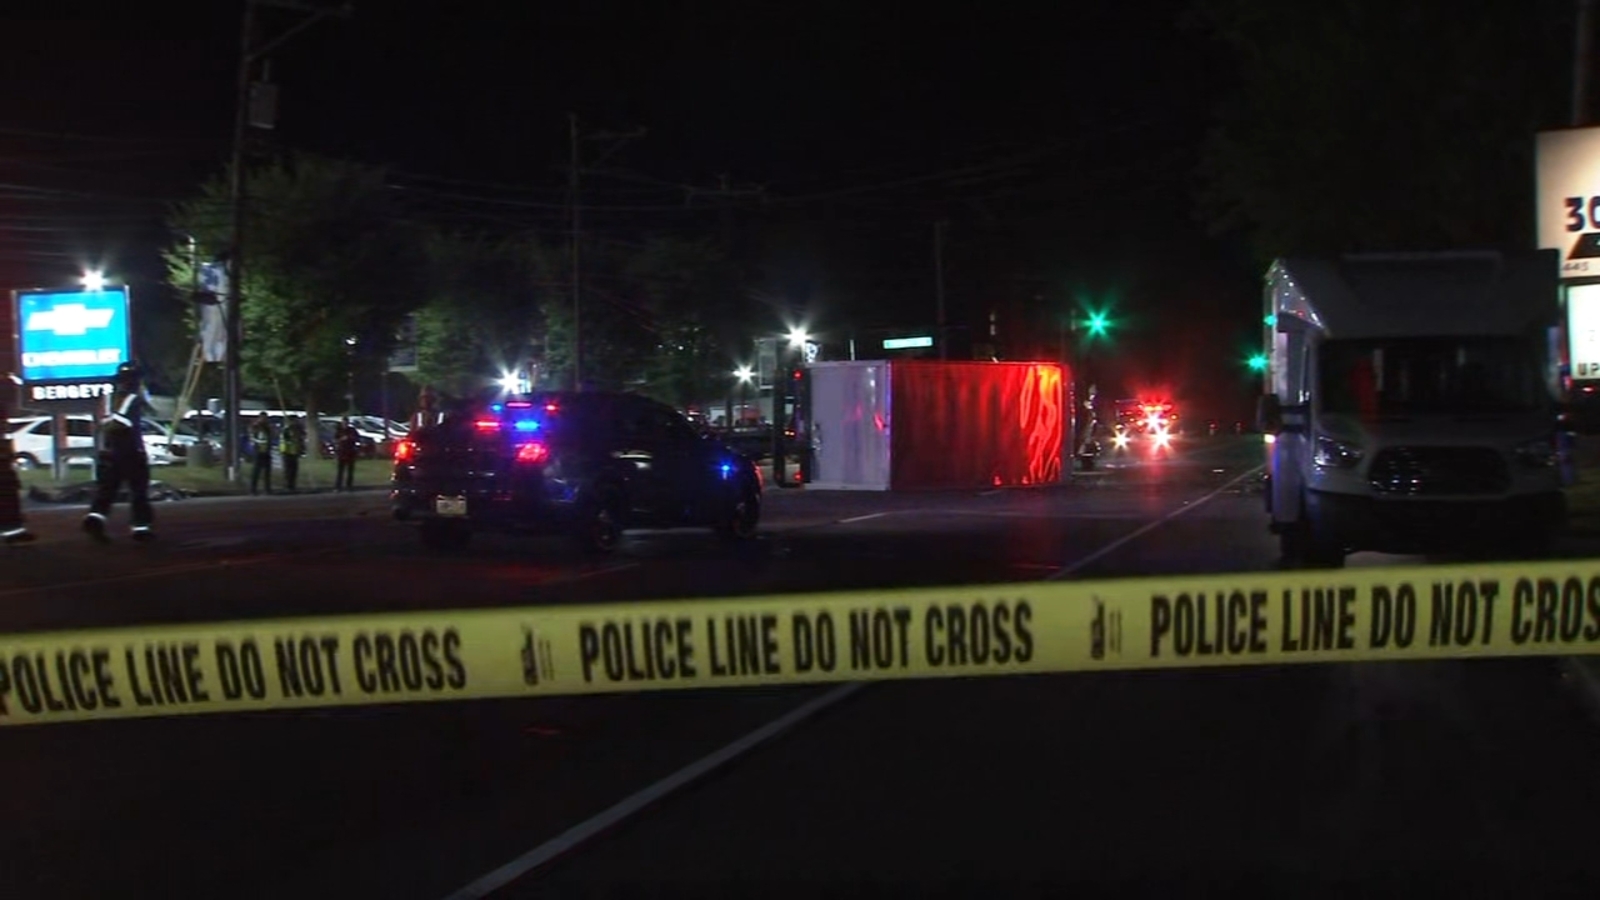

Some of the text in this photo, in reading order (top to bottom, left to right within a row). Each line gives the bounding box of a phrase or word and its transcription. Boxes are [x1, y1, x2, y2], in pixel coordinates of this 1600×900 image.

[579, 618, 697, 684] POLICE
[707, 614, 782, 676] LINE
[792, 611, 837, 673] DO
[849, 607, 912, 670] NOT
[925, 600, 1034, 667] CROSS
[1150, 590, 1268, 657] POLICE
[1280, 586, 1357, 652] LINE
[1369, 583, 1416, 649] DO
[1428, 580, 1500, 646] NOT
[125, 641, 210, 706] LINE
[215, 639, 267, 700] DO
[274, 636, 343, 697] NOT
[353, 628, 467, 694] CROSS
